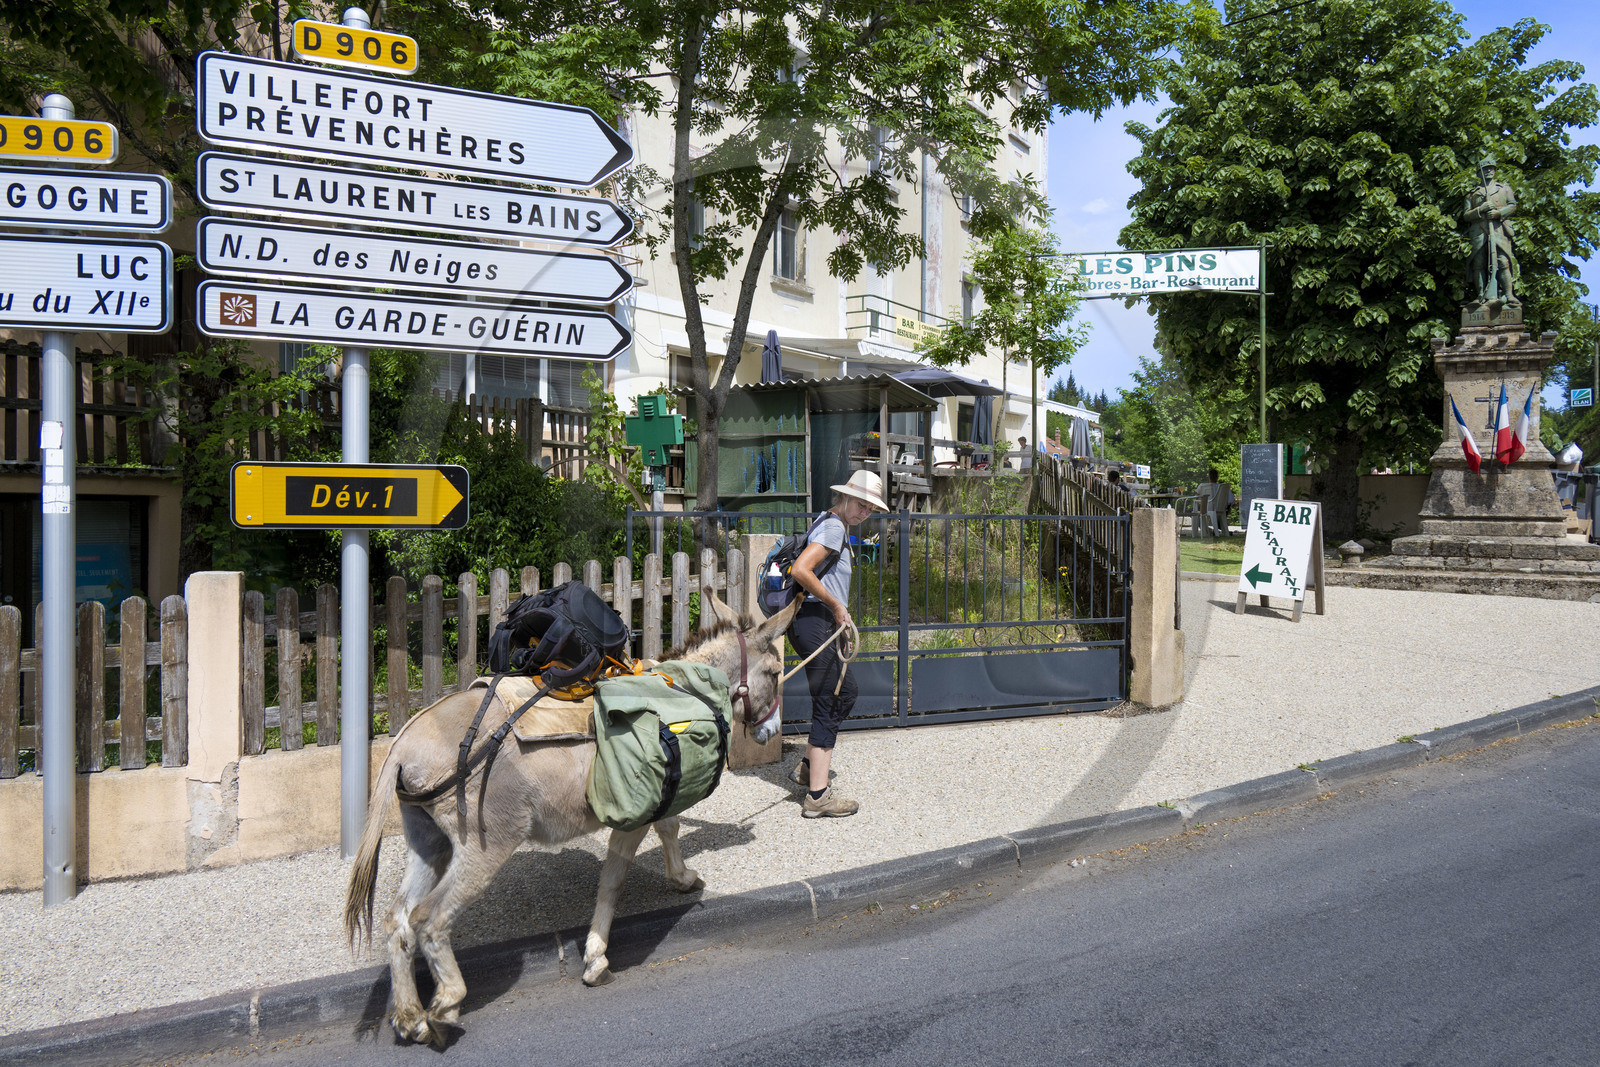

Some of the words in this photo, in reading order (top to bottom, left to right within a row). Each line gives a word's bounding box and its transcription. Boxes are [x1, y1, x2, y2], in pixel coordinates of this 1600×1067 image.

[303, 26, 322, 51] D
[336, 32, 408, 64] 906
[219, 68, 433, 121] VILLEFORT
[218, 101, 525, 165] PRÉVENCHÈRES
[6, 182, 149, 215] GOGNE
[272, 174, 437, 215] LAURENT
[454, 203, 490, 221] LES
[507, 201, 602, 233] BAINS
[77, 253, 149, 281] LUC
[219, 233, 288, 263] N.D.
[313, 243, 369, 269] des
[389, 249, 499, 284] Neiges
[1078, 256, 1134, 276] LES
[1144, 253, 1218, 274] PINS
[32, 288, 71, 314] du
[270, 301, 310, 327] LA
[334, 305, 585, 346] GARDE-GUÉRIN
[901, 318, 915, 329] BAR
[310, 484, 394, 509] Dév.1
[1273, 504, 1312, 525] BAR
[1253, 502, 1301, 596] RESTAURANT
